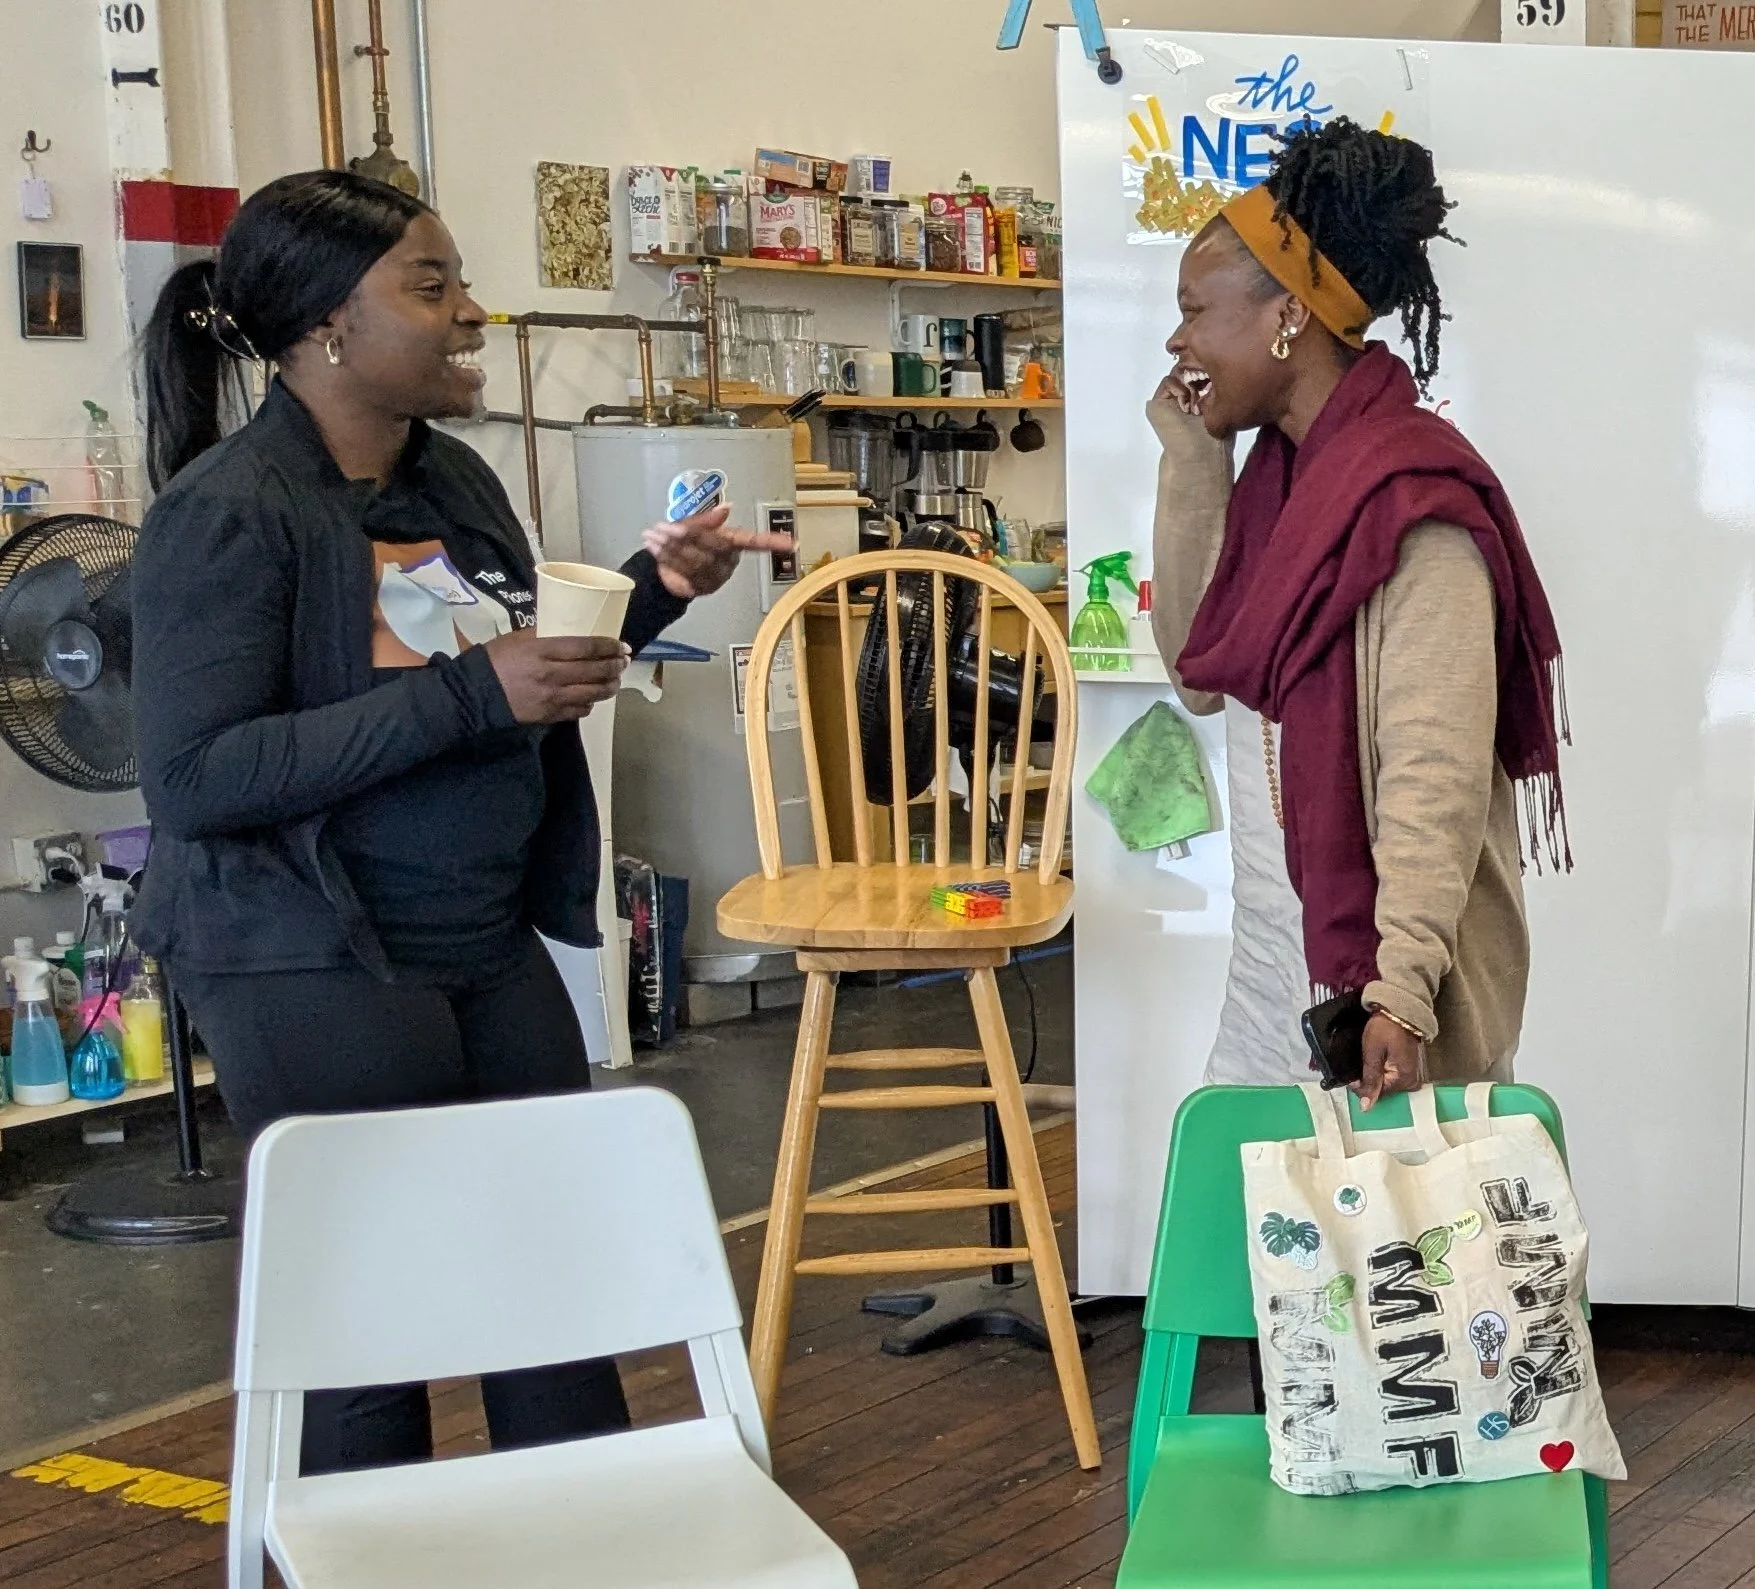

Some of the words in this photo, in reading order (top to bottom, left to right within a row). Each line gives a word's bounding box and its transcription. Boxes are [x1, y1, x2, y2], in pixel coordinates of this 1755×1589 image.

[105, 3, 145, 33] 60
[1516, 0, 1566, 26] 59
[1676, 3, 1717, 20] THAT
[1676, 25, 1710, 43] THE
[1235, 53, 1333, 114] the
[1182, 114, 1322, 188] NE
[475, 570, 507, 585] The
